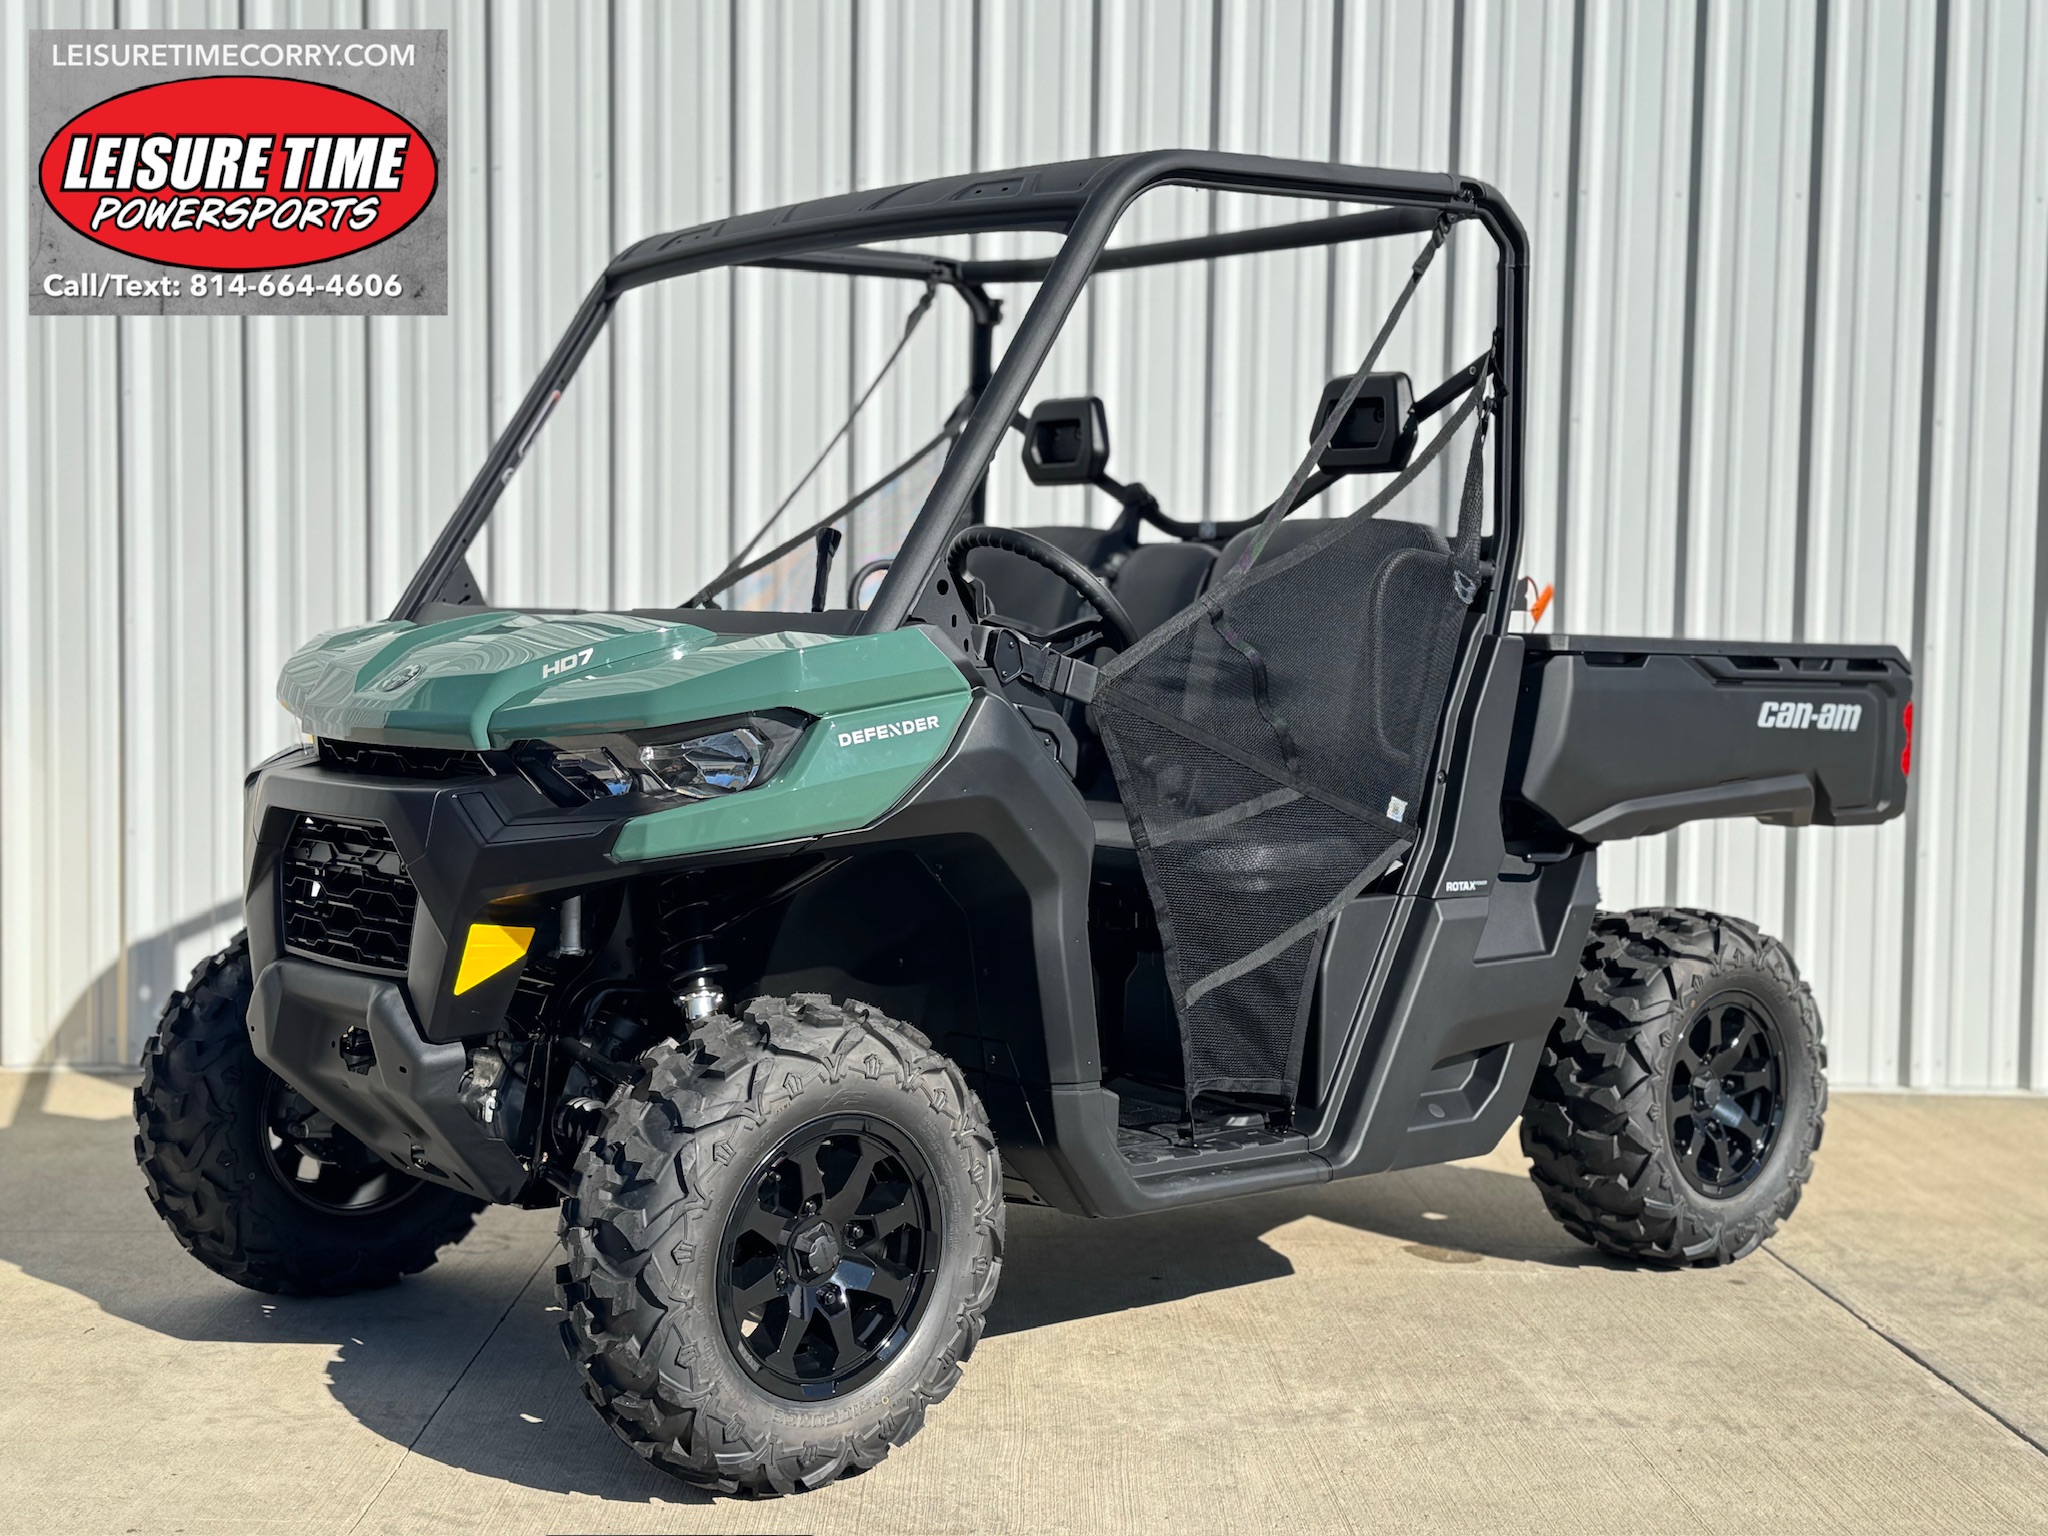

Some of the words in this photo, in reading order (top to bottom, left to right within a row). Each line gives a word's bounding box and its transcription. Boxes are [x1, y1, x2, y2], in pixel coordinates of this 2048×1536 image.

[542, 647, 595, 680] HD7
[838, 715, 940, 748] DEFENDER
[1446, 880, 1476, 892] ROTAX
